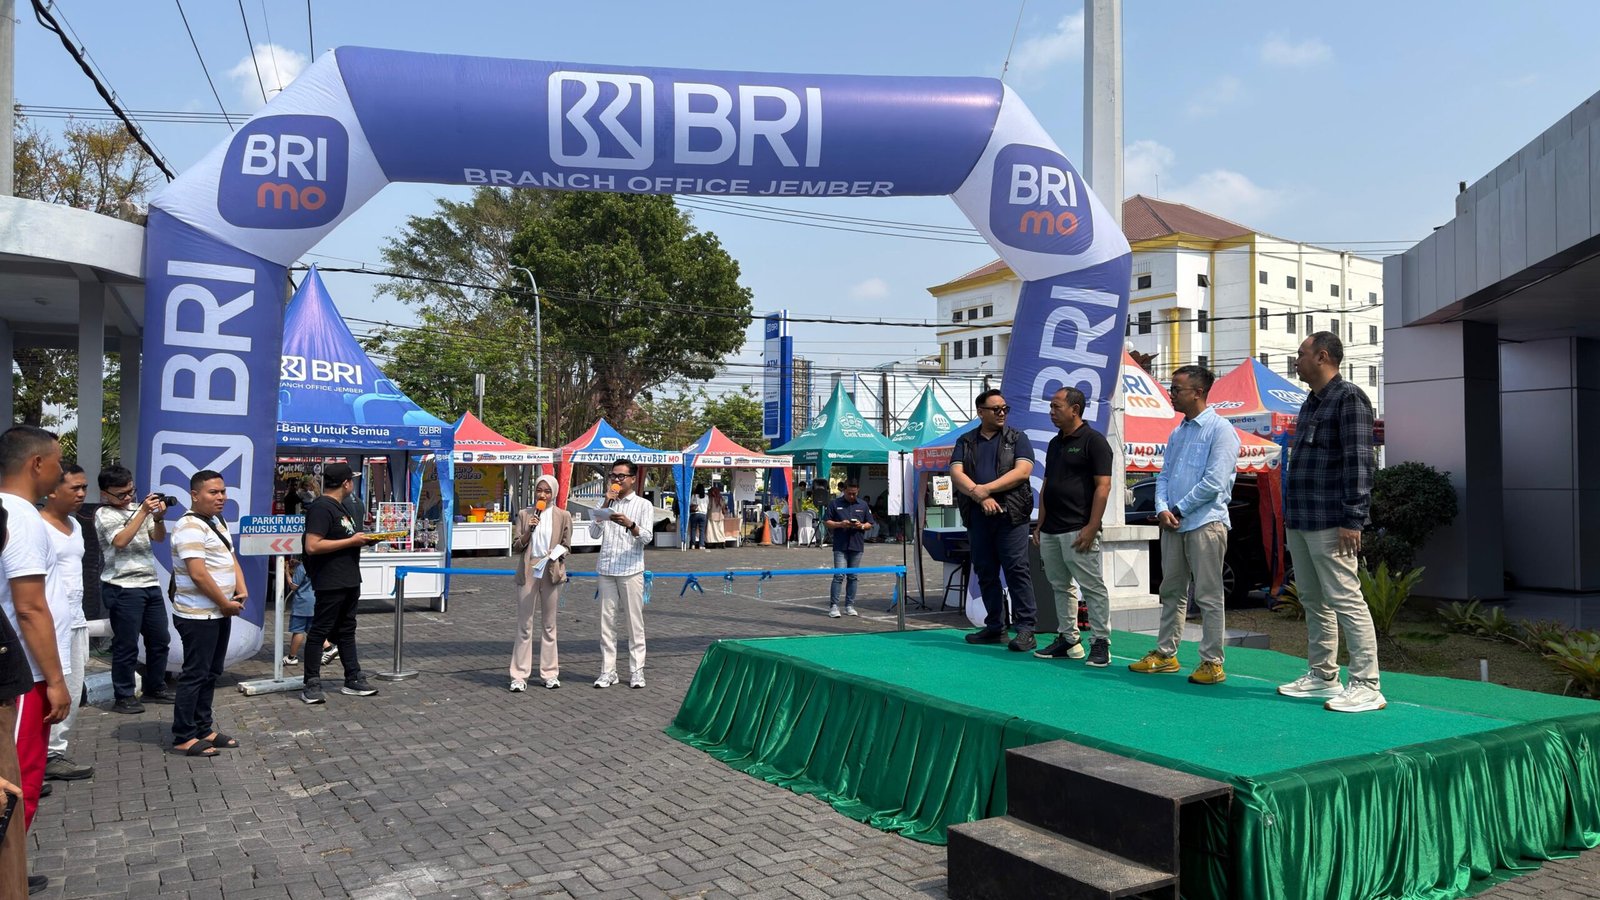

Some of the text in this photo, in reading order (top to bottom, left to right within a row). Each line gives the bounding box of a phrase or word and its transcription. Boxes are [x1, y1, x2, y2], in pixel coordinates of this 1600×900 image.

[673, 82, 823, 168] BRI
[242, 134, 328, 182] BRI
[463, 168, 895, 196] BRANCH OFFICE JEMBER
[1008, 164, 1078, 207] BRI
[257, 182, 327, 210] mo
[1020, 210, 1079, 235] mo
[161, 260, 255, 416] BRI
[1029, 285, 1120, 422] BRI
[311, 359, 363, 385] BRI
[305, 384, 332, 392] OFFICE
[334, 386, 363, 394] JEMBER
[1127, 394, 1161, 409] mo
[282, 423, 390, 437] Bank Untuk Semua
[428, 426, 442, 434] BRI
[242, 525, 278, 534] KHUSUS
[252, 516, 284, 525] PARKIR
